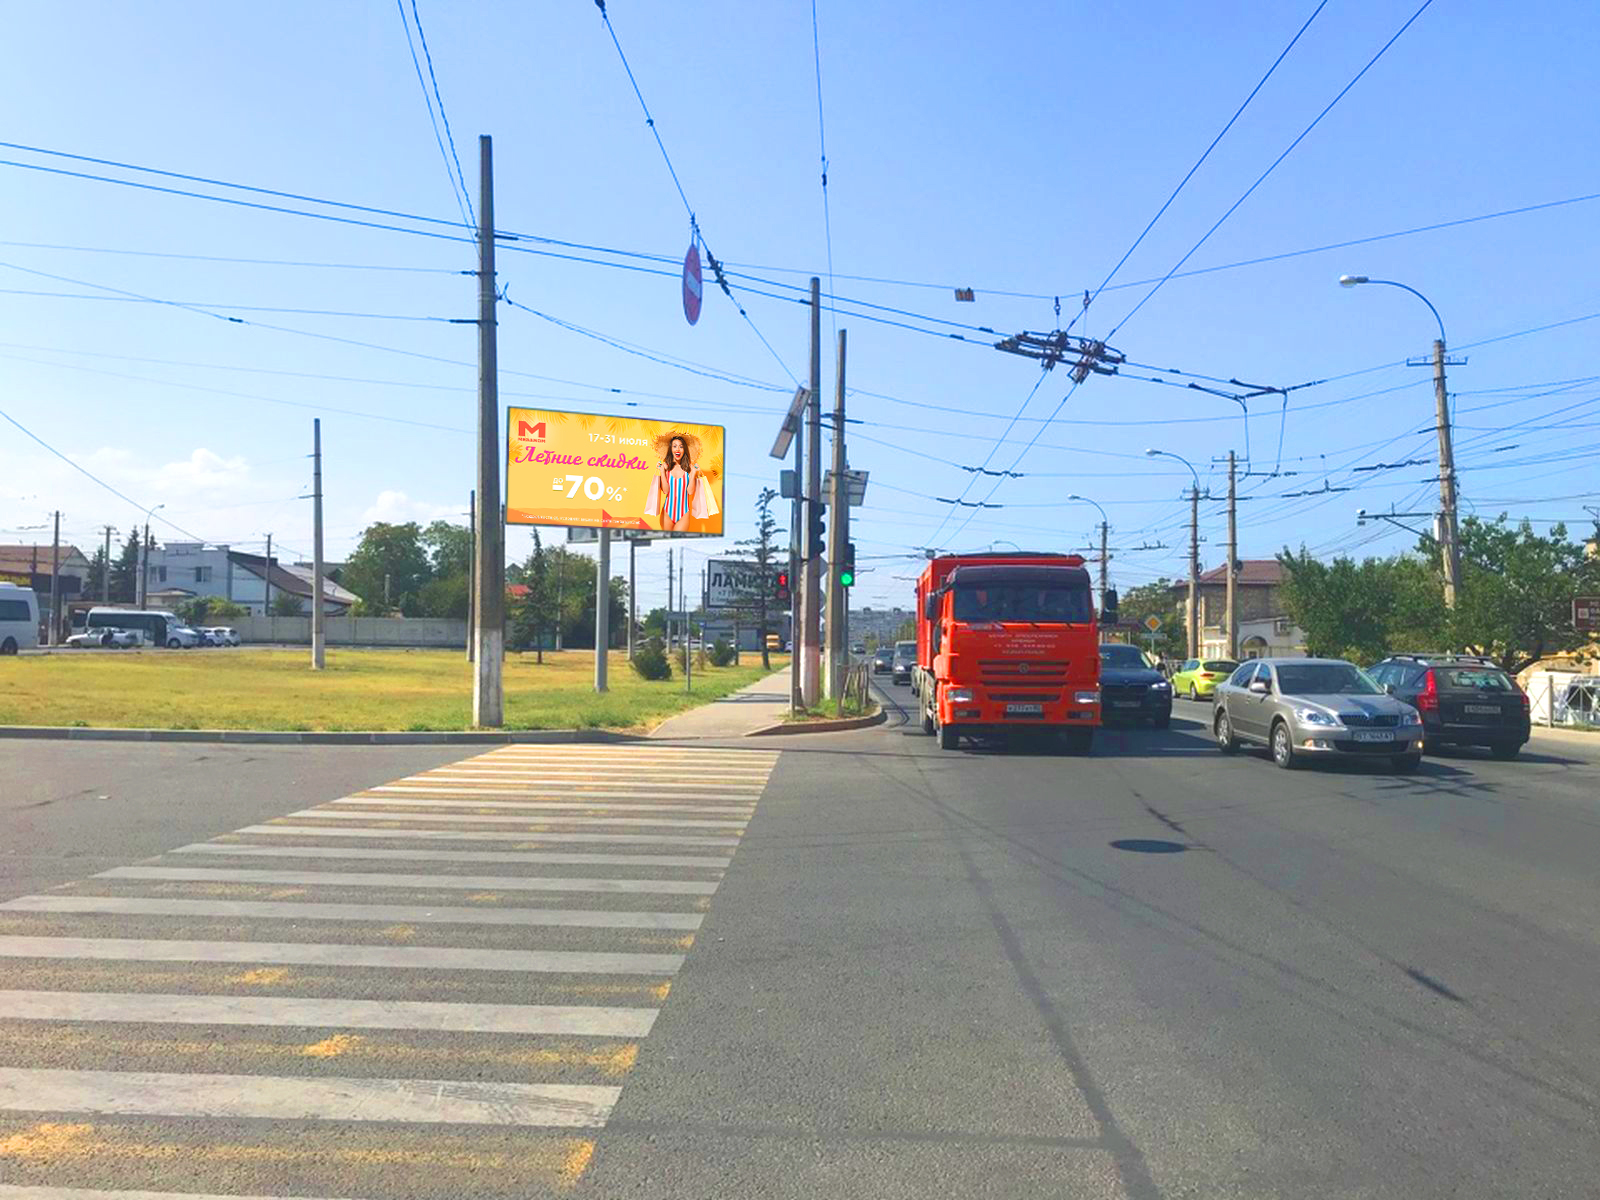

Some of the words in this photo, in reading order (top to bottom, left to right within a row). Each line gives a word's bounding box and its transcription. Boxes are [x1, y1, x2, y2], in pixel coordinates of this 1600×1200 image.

[588, 433, 616, 445] 17-31
[515, 446, 584, 466] Летние
[587, 453, 649, 471] скидки
